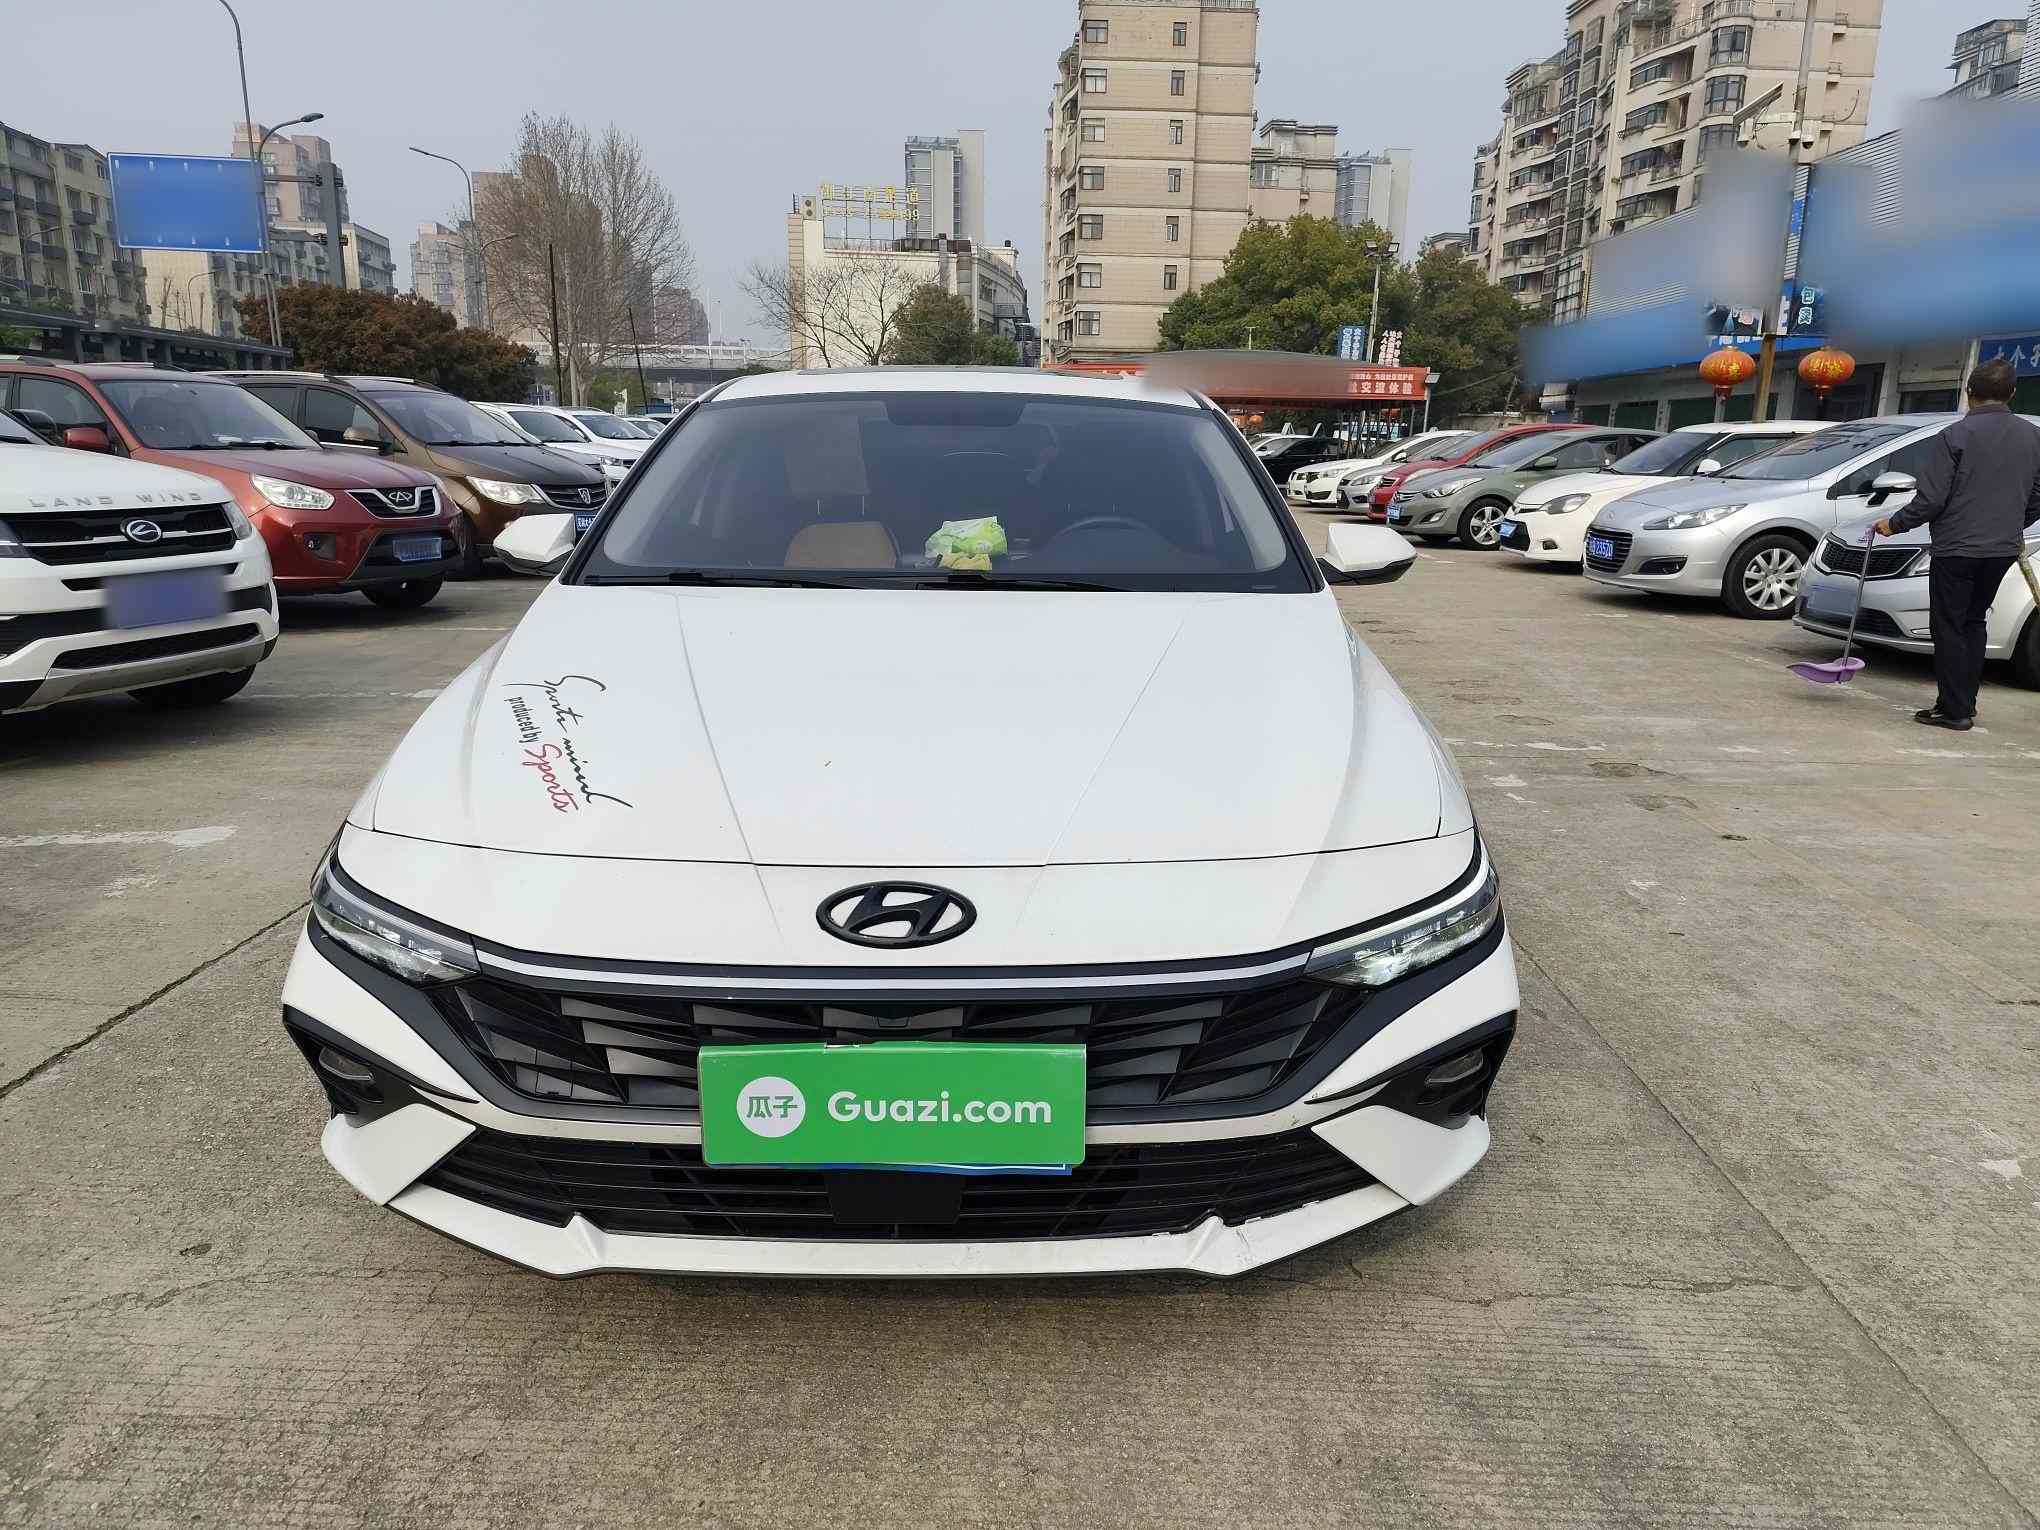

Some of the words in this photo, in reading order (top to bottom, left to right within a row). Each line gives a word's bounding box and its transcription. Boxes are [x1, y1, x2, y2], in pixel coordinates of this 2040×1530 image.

[28, 495, 113, 508] LAND
[136, 489, 202, 503] WIND
[503, 696, 542, 732] produced
[518, 731, 543, 744] by
[522, 743, 579, 813] Sports
[745, 1095, 799, 1120] 瓜子
[827, 1091, 1053, 1124] Guazi.com
